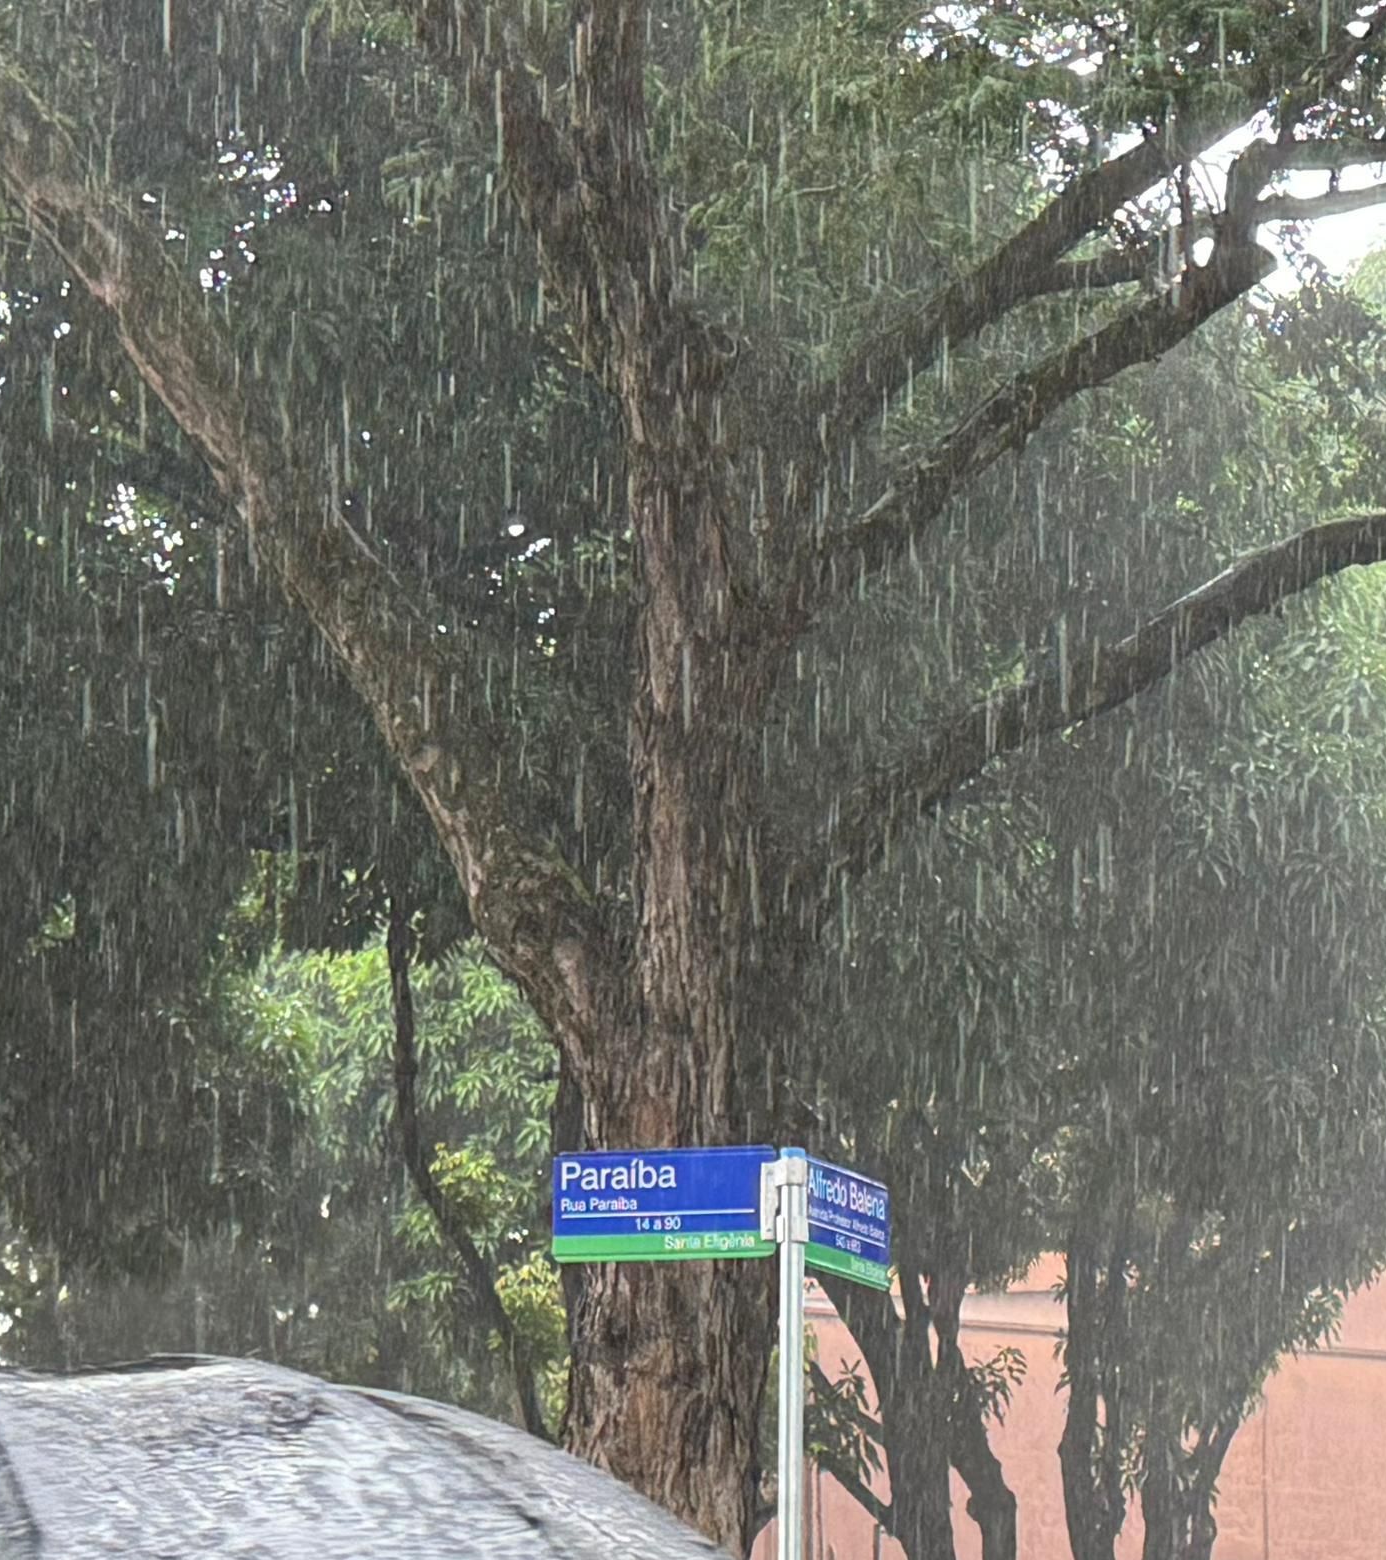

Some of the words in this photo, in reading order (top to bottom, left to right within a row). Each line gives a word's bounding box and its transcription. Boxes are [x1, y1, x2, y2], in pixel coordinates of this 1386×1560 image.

[561, 1158, 677, 1191] Paraíba
[808, 1167, 848, 1207] Alfredo
[849, 1181, 885, 1220] Balena
[561, 1198, 586, 1211] Rua
[635, 1217, 650, 1231] 14
[653, 1219, 662, 1230] a
[664, 1216, 681, 1230] 90
[665, 1234, 701, 1249] Santa
